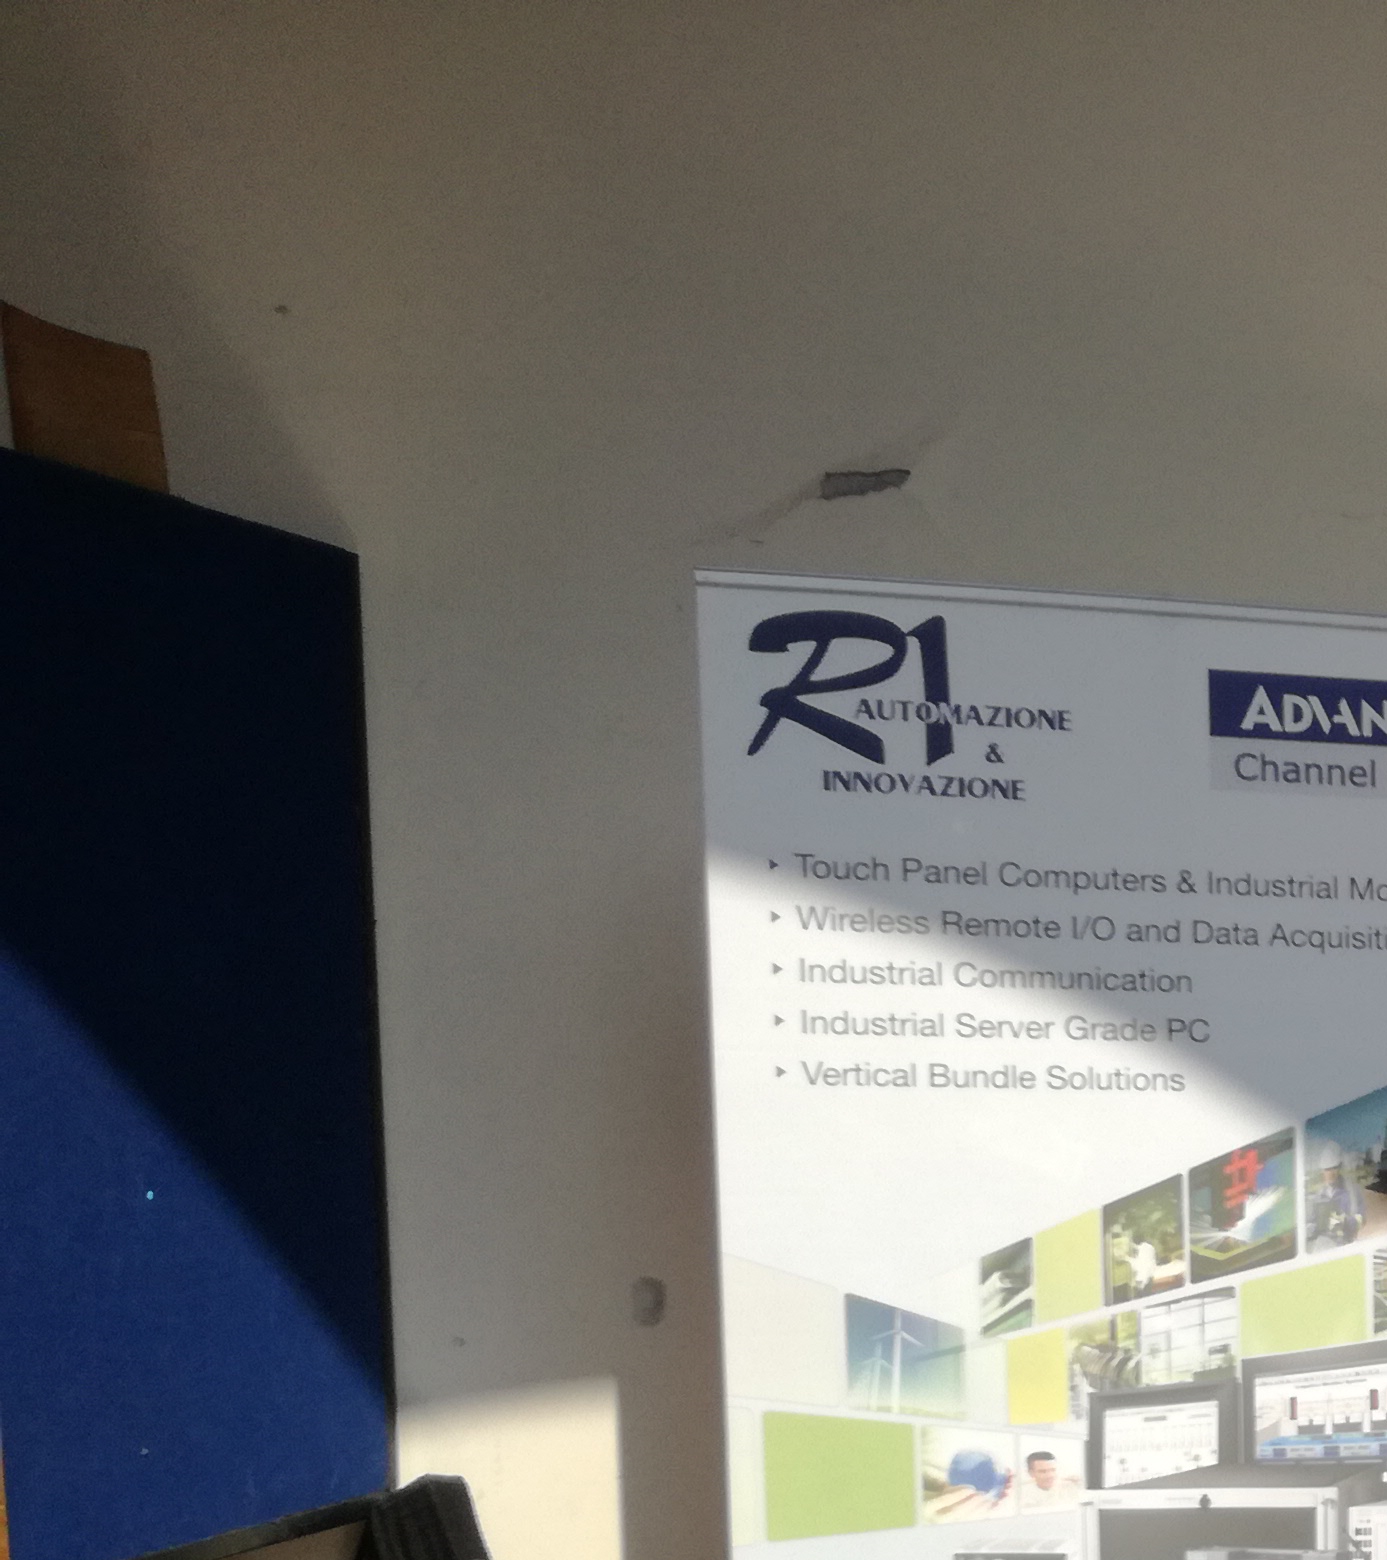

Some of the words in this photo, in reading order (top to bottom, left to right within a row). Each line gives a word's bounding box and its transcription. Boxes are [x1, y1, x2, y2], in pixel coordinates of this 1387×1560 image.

[856, 697, 1073, 732] AUTOMAZIONE
[985, 743, 1006, 765] &
[1233, 752, 1378, 789] Channel
[821, 768, 1027, 802] INNOVAZIONE
[793, 852, 891, 884] Touch
[901, 856, 988, 888] Panel
[998, 860, 1167, 897] Computers
[1176, 869, 1198, 895] &
[1208, 869, 1340, 901] Industrial
[795, 905, 931, 936] Wireless
[941, 909, 1061, 941] Remote
[1071, 913, 1116, 942] I/O
[1126, 916, 1182, 946] and
[1192, 919, 1260, 948] Data
[798, 957, 944, 989] Industrial
[953, 961, 1193, 994] Communication
[800, 1009, 946, 1040] Industrial
[956, 1013, 1053, 1042] Server
[1063, 1015, 1156, 1044] Grade
[1167, 1018, 1211, 1046] PC
[800, 1061, 918, 1090] Vertical
[928, 1063, 1037, 1092] Bundle
[1046, 1065, 1187, 1094] Solutions
